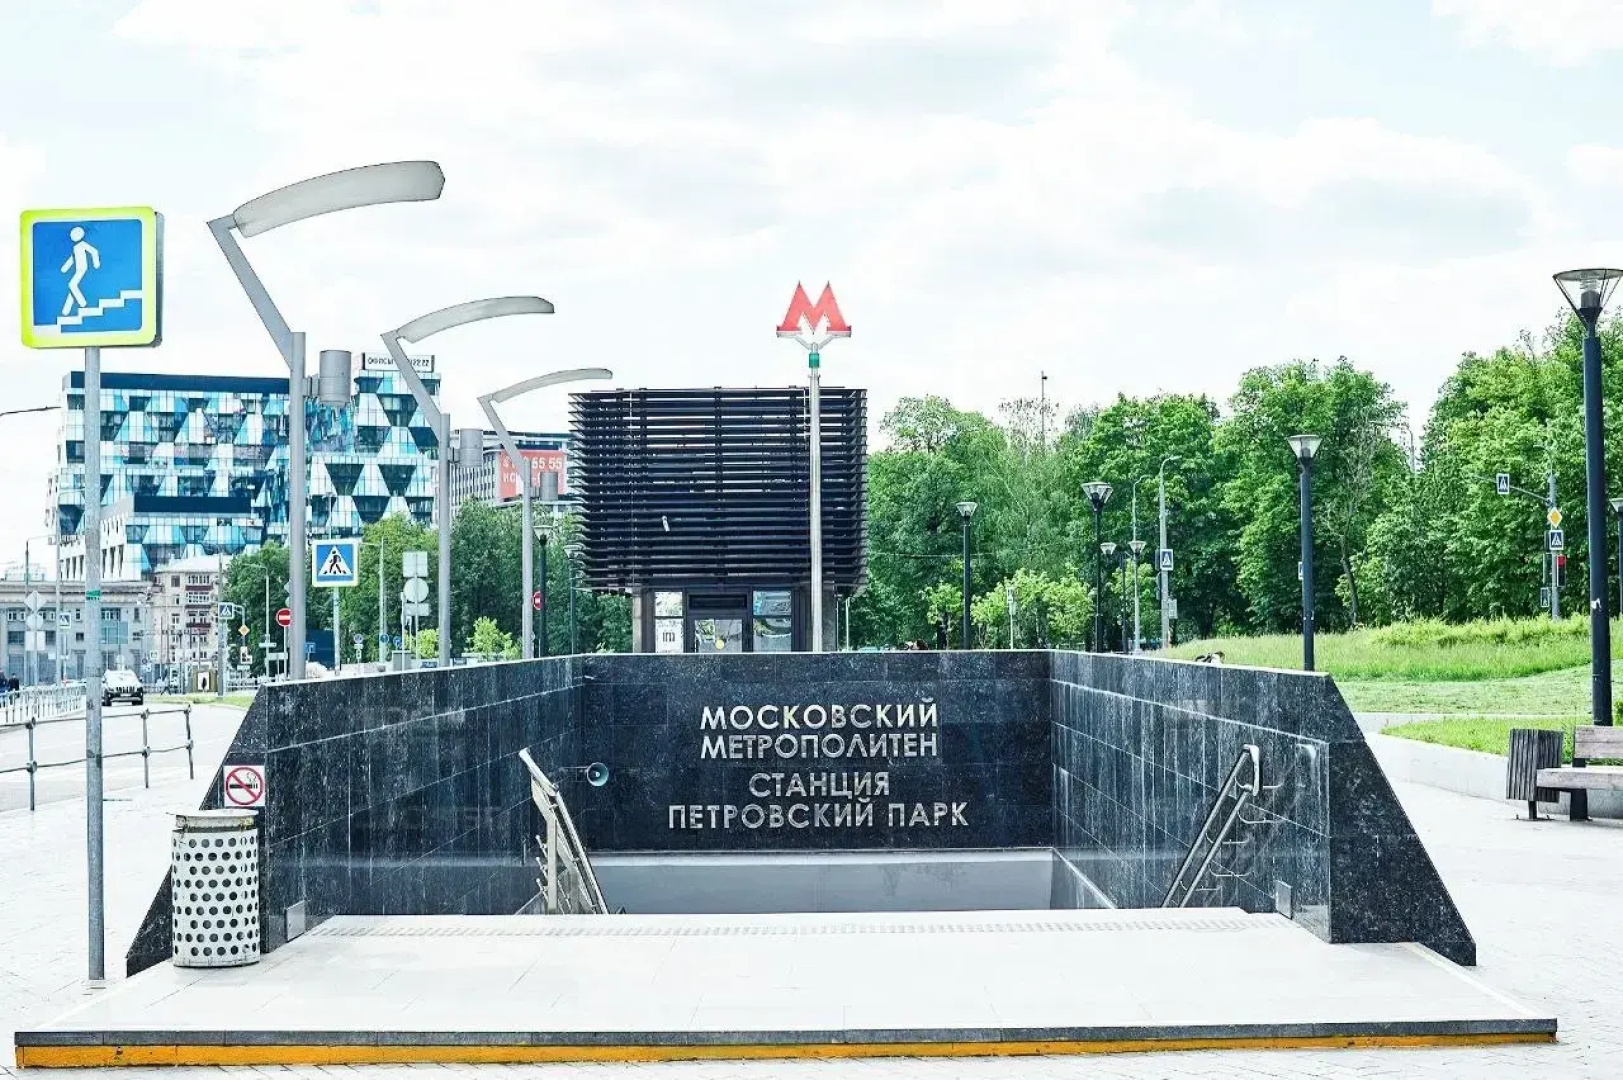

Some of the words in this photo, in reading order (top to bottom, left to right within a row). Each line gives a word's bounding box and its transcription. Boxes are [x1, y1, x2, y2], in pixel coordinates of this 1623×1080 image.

[700, 697, 938, 730] МОСКОВСКИЙ
[700, 733, 938, 759] МЕТРОПОЛИТЕН
[749, 771, 890, 799] СТАНЦИЯ
[668, 797, 874, 829] ПЕТРОВСКИЙ
[888, 801, 969, 827] ПАРК
